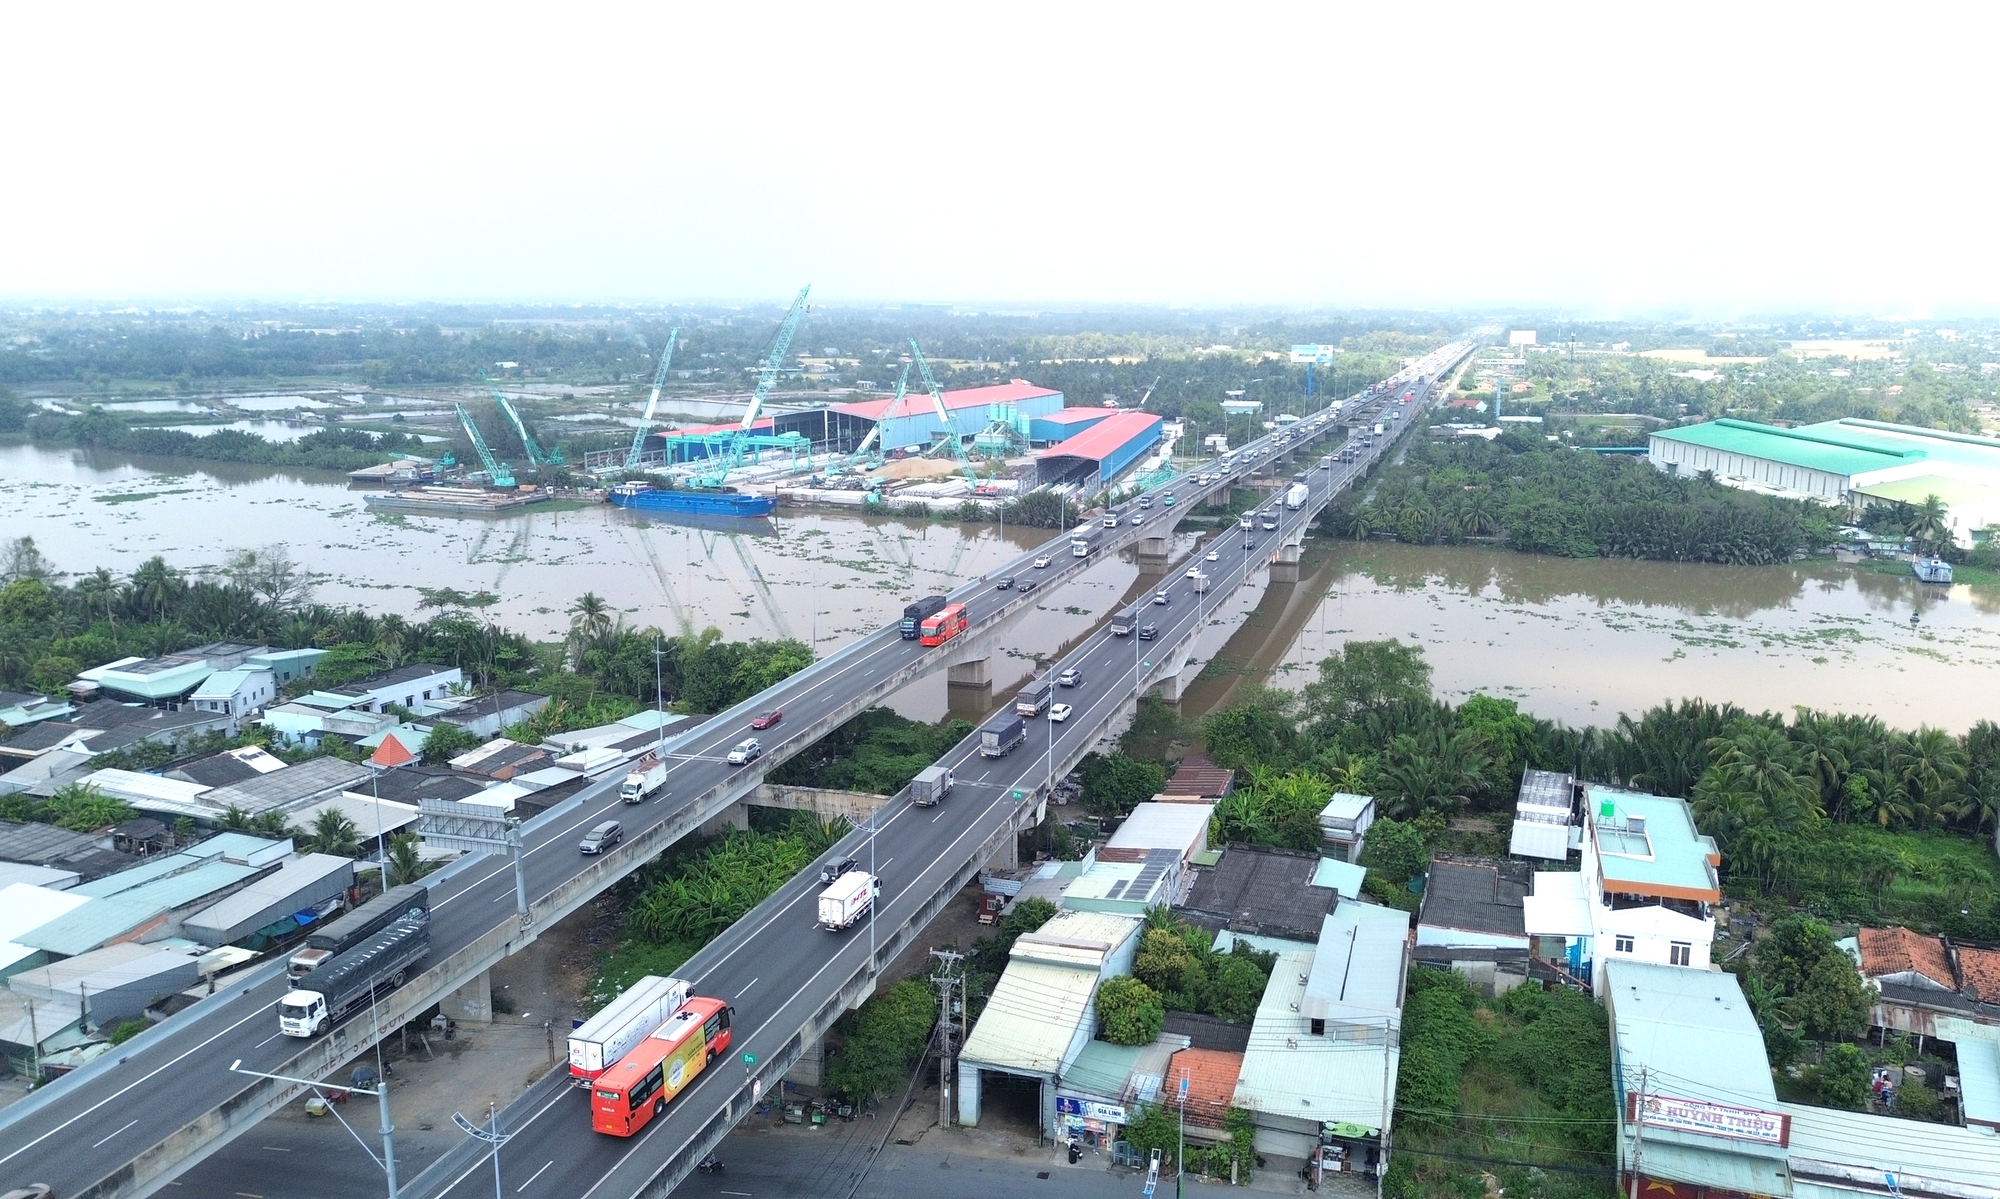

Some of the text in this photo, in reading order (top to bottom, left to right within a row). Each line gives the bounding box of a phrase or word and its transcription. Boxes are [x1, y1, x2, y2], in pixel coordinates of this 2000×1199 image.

[379, 1012, 406, 1035] GON
[1098, 1107, 1107, 1115] GIA
[1727, 1115, 1776, 1133] TRIỆU
